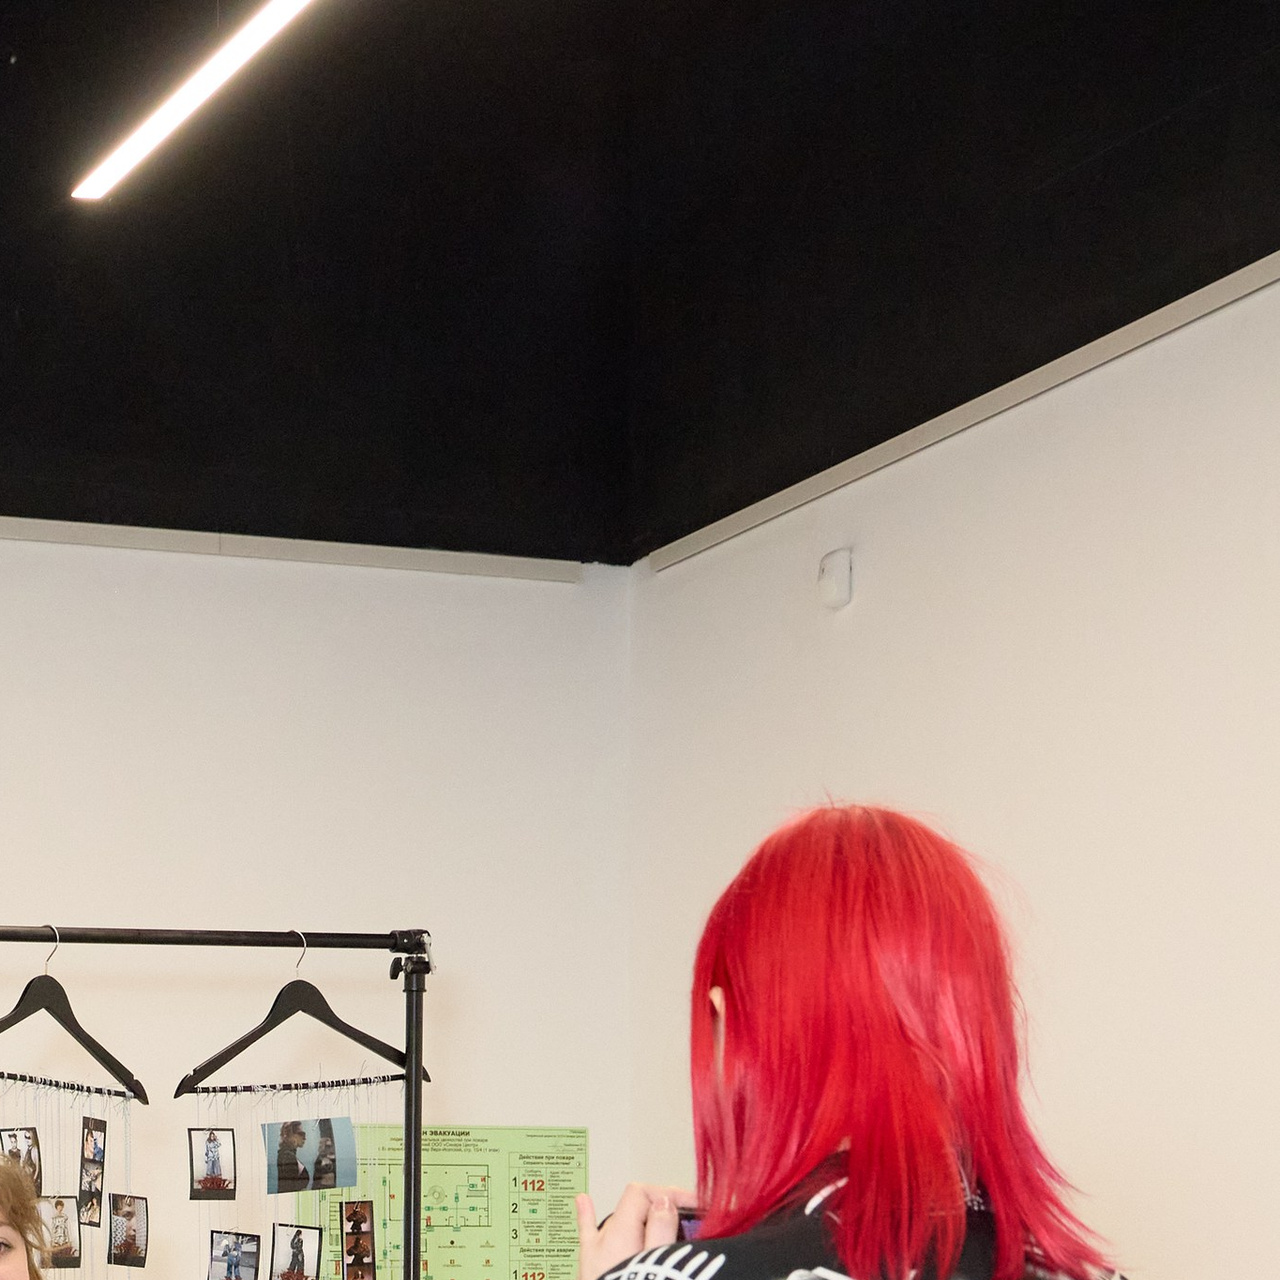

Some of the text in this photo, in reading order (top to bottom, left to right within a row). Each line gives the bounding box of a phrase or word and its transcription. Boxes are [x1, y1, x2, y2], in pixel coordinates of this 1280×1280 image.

[512, 1176, 517, 1187] 1
[521, 1179, 545, 1191] 112
[511, 1202, 518, 1213] 2
[511, 1228, 518, 1240] 3
[512, 1269, 518, 1280] 1
